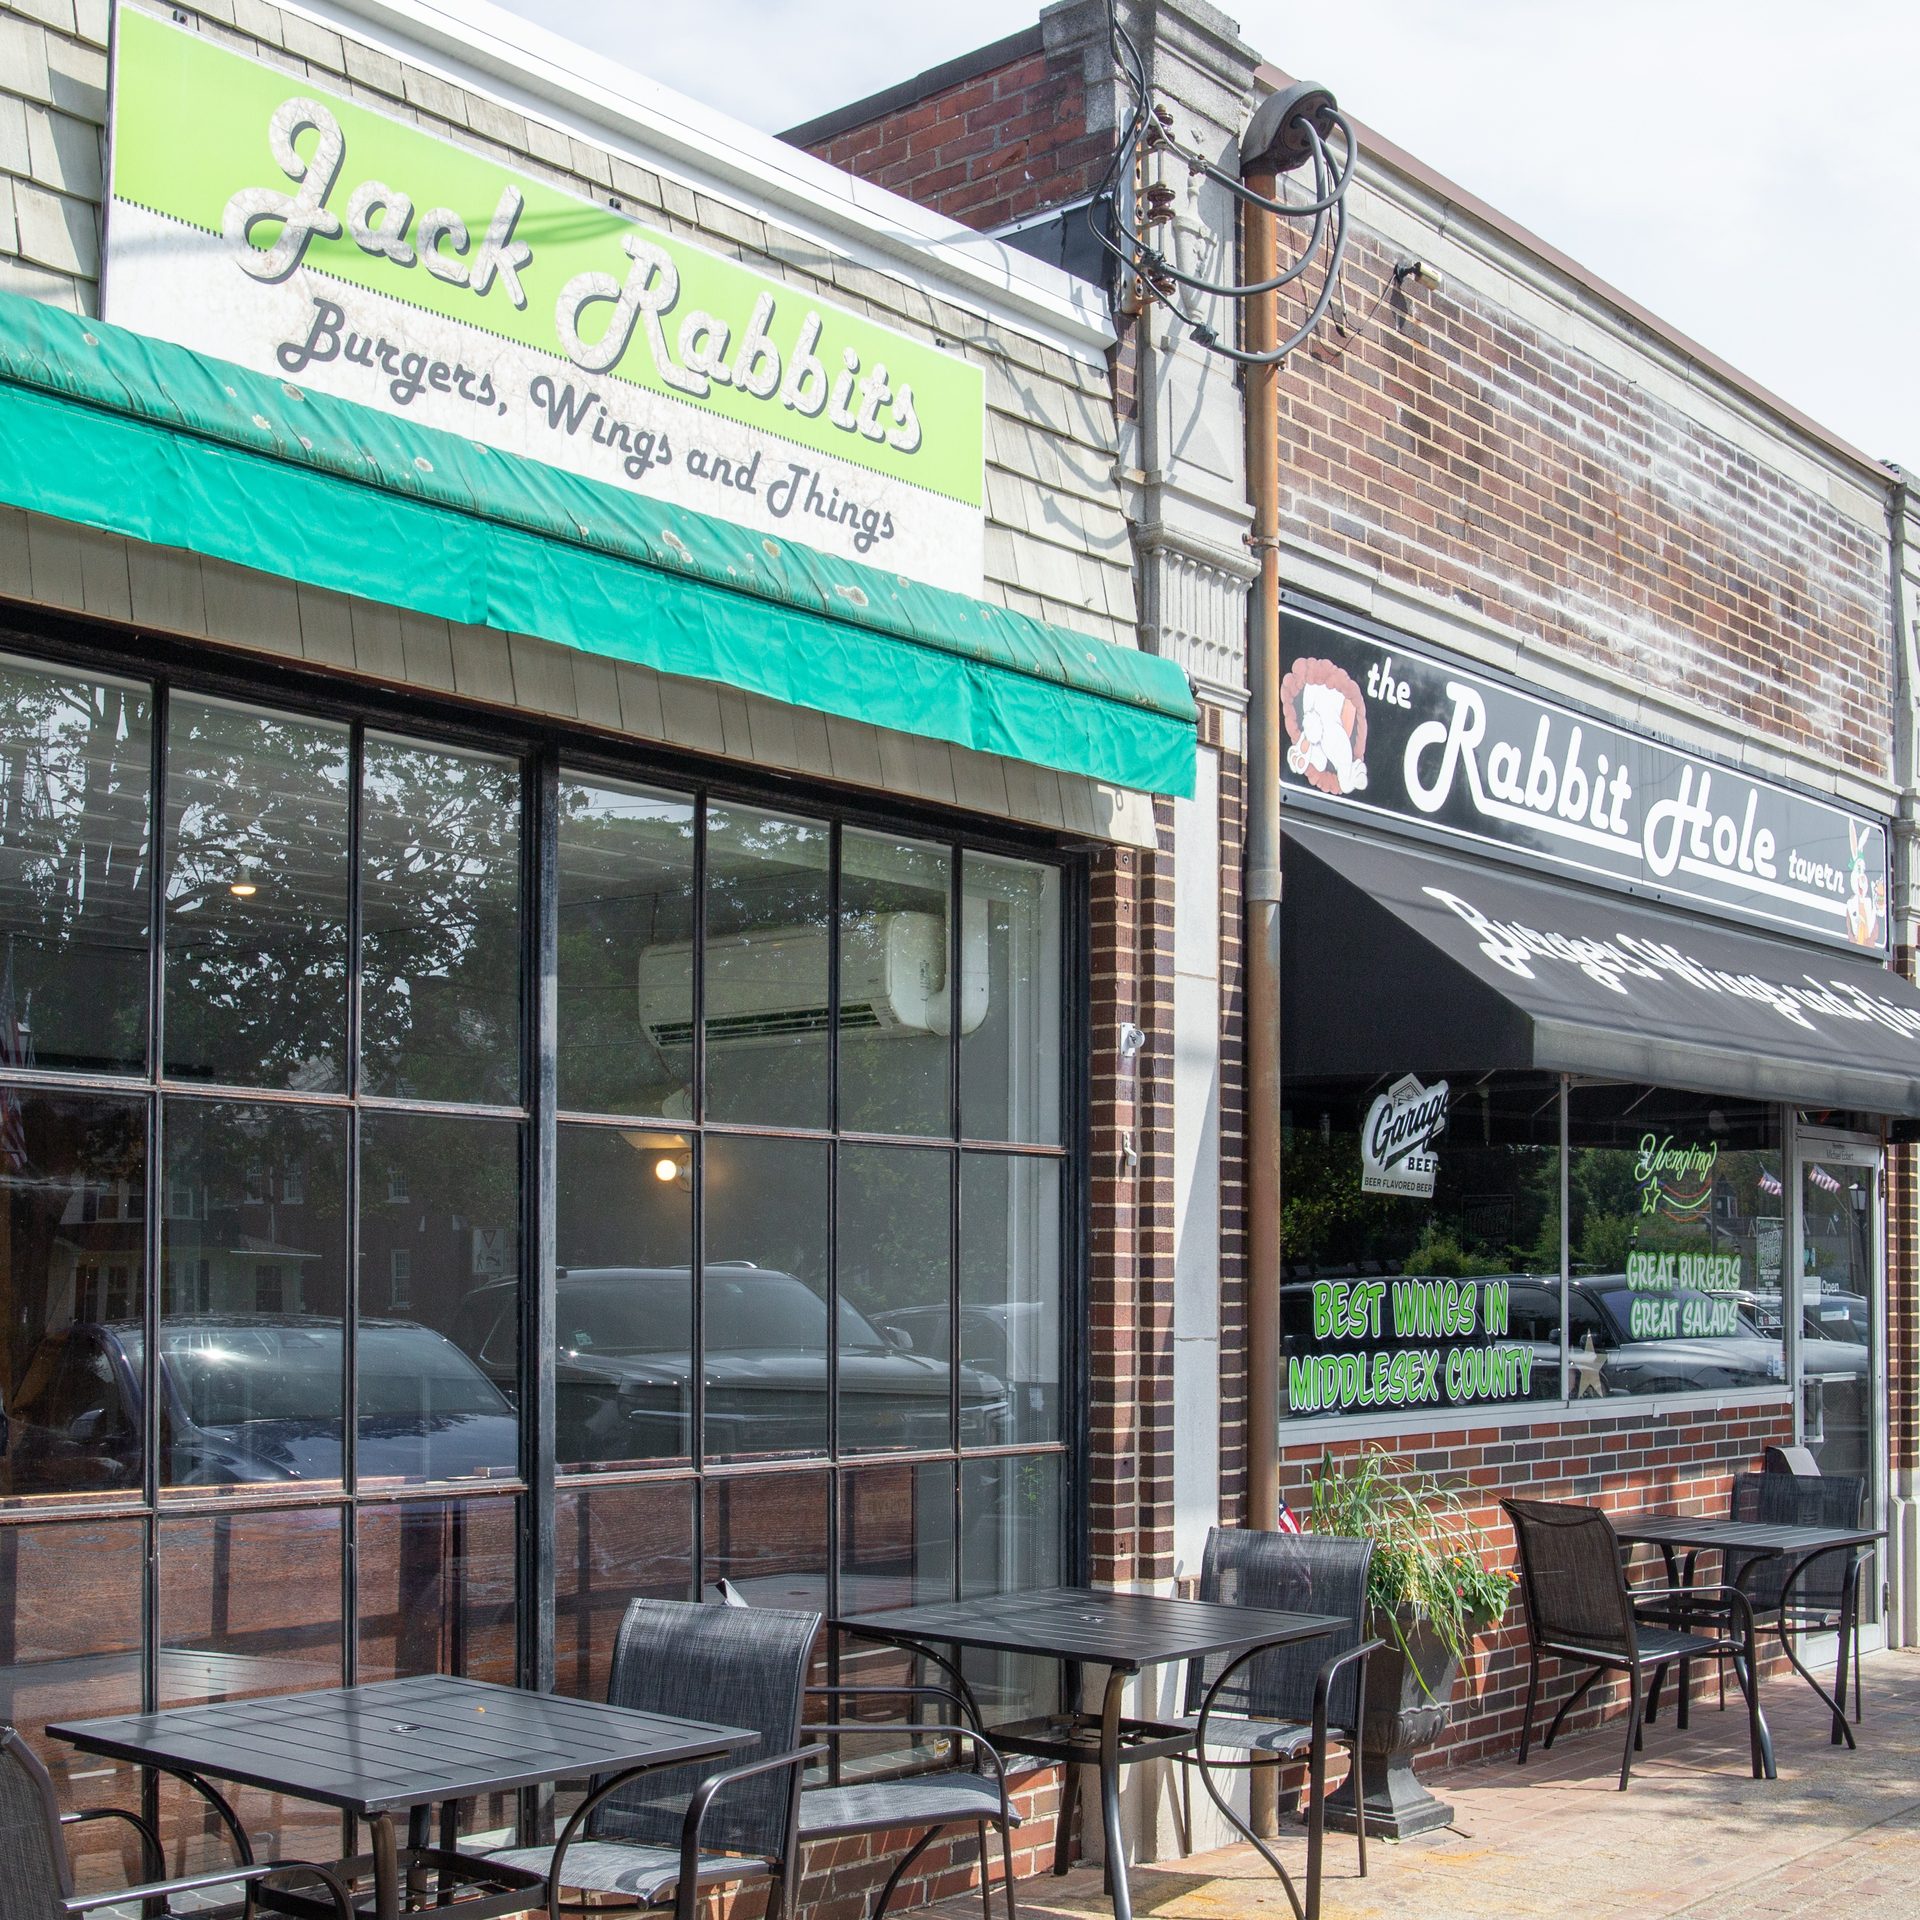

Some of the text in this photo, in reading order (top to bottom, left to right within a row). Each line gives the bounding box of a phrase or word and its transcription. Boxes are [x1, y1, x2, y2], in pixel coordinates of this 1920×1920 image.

[222, 97, 923, 455] Jack Rabbits
[276, 297, 895, 553] Burgers, Wings and Things
[1367, 657, 1845, 894] the Rabbit Hole tavern
[1422, 887, 1664, 995] Burgers
[1616, 933, 1816, 1030] Wings
[1782, 974, 1872, 1021] and
[1372, 1089, 1450, 1167] Garage
[1635, 1134, 1717, 1182] Yuengling
[1364, 1177, 1433, 1193] BEER FLAVORED BEER
[1626, 1250, 1676, 1291] GREAT
[1678, 1252, 1741, 1291] BURGERS
[1821, 1280, 1840, 1296] Open
[1313, 1279, 1509, 1339] BEST WINGS IN
[1630, 1298, 1739, 1338] GREAT SALADS
[1288, 1345, 1534, 1411] MIDDLESEX COUNTY
